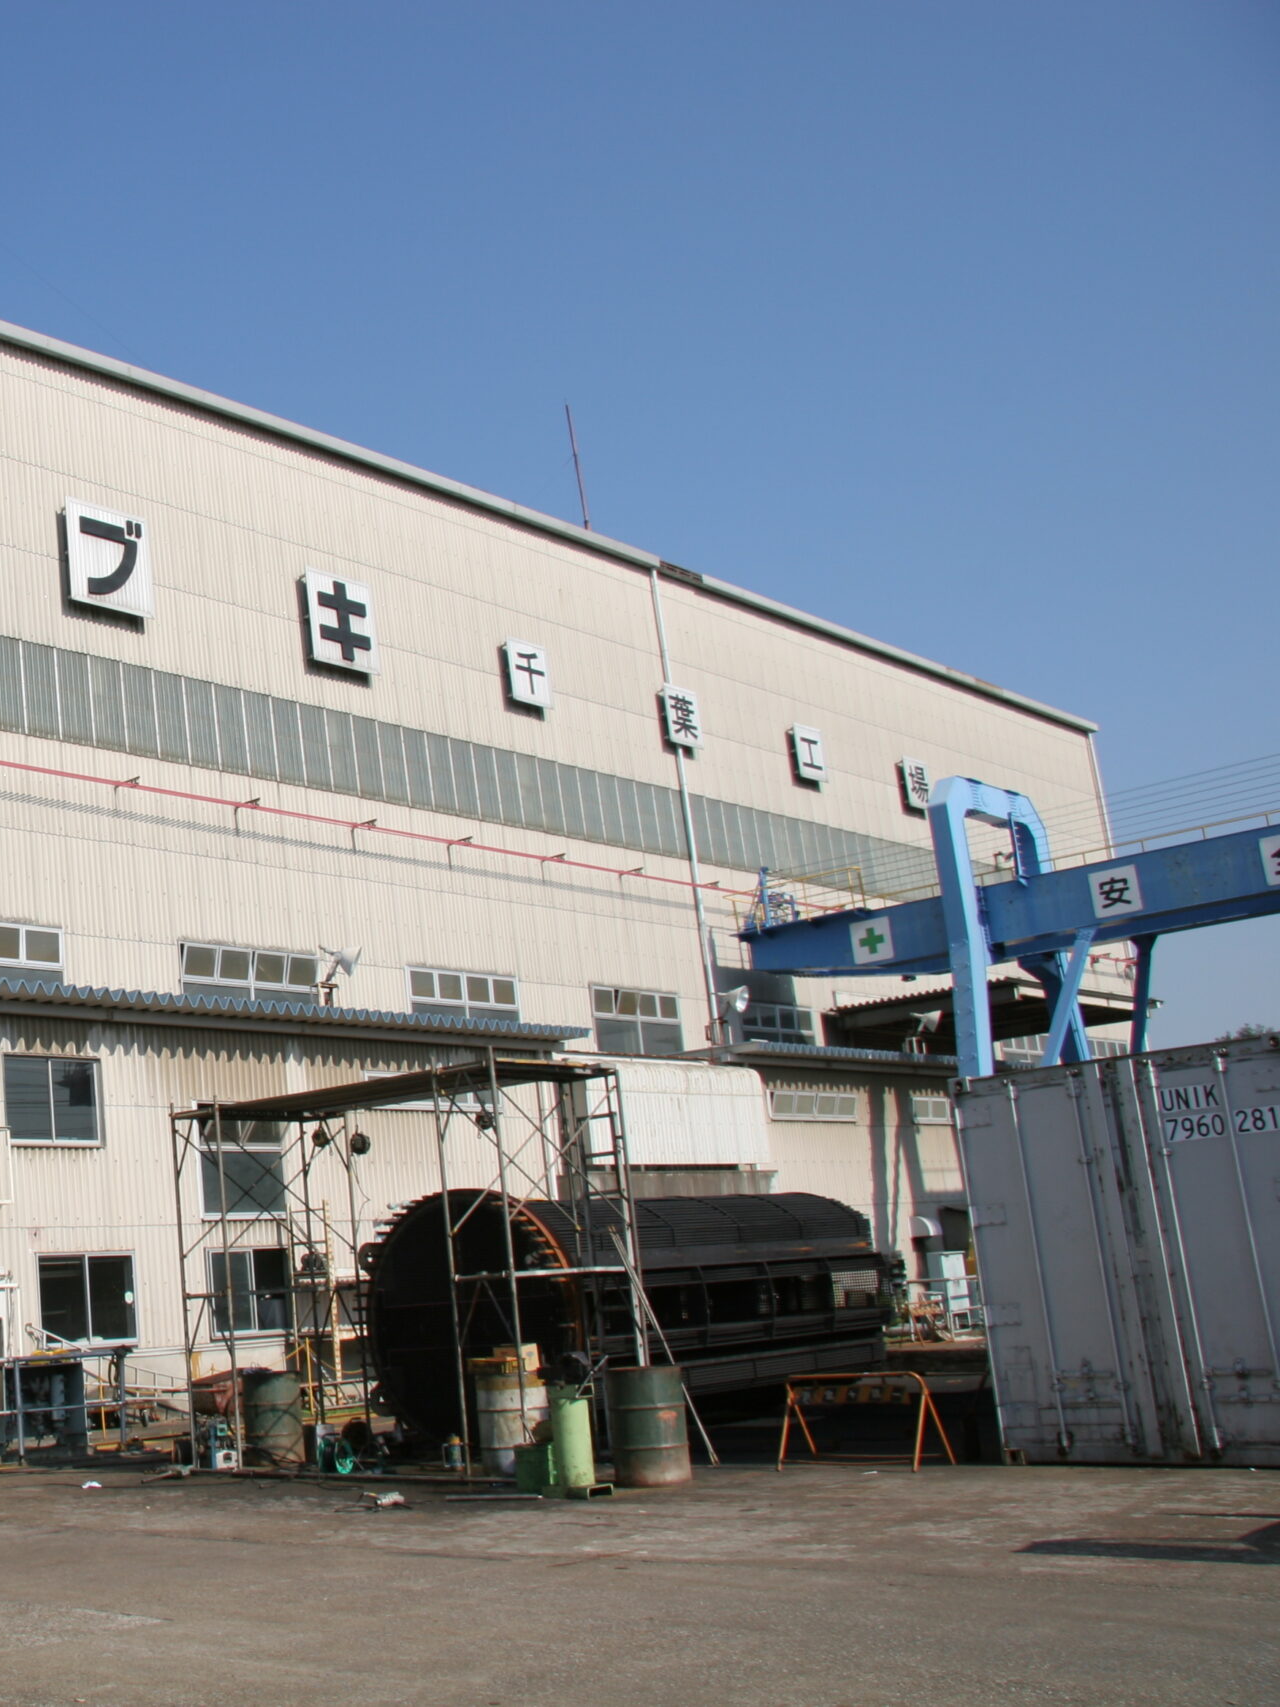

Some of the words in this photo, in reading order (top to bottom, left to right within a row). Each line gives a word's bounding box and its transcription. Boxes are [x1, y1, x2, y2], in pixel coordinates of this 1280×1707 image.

[1160, 1084, 1220, 1112] UNIK
[1166, 1114, 1225, 1141] 7960
[1235, 1107, 1278, 1132] 281
